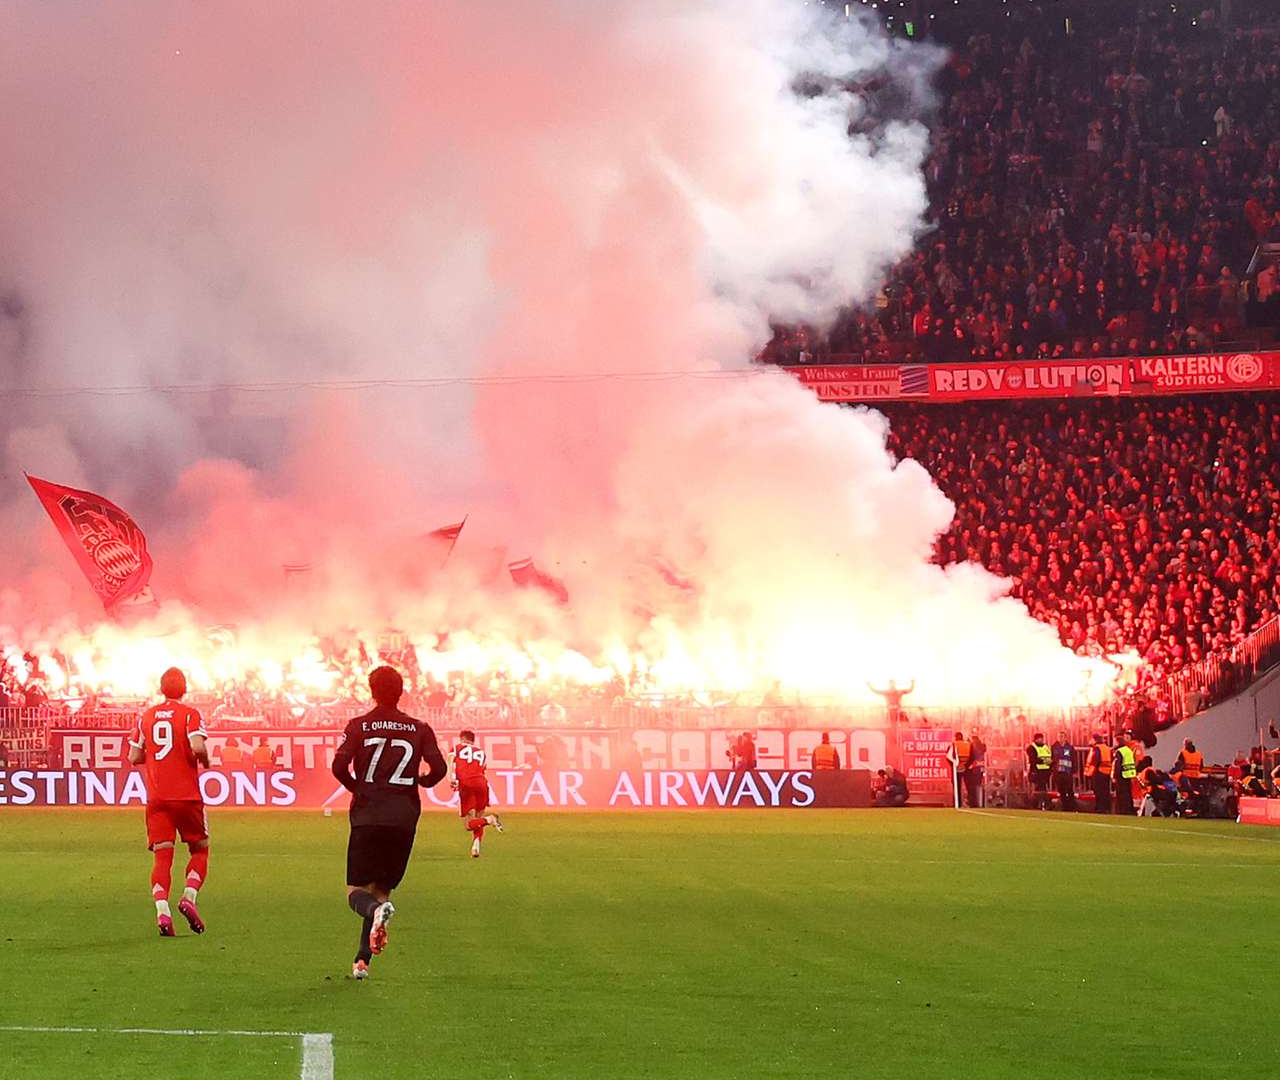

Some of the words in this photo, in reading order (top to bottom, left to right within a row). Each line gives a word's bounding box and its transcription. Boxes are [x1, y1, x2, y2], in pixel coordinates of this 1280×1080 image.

[1140, 356, 1225, 378] KALTERN
[1156, 372, 1224, 386] SÜDTIROL
[372, 721, 416, 732] QUARESMA
[153, 721, 173, 760] 9
[363, 737, 414, 785] 72
[459, 746, 486, 766] 44
[915, 758, 940, 767] HATE
[909, 768, 948, 777] RACISM
[609, 770, 815, 807] AIRWAYS
